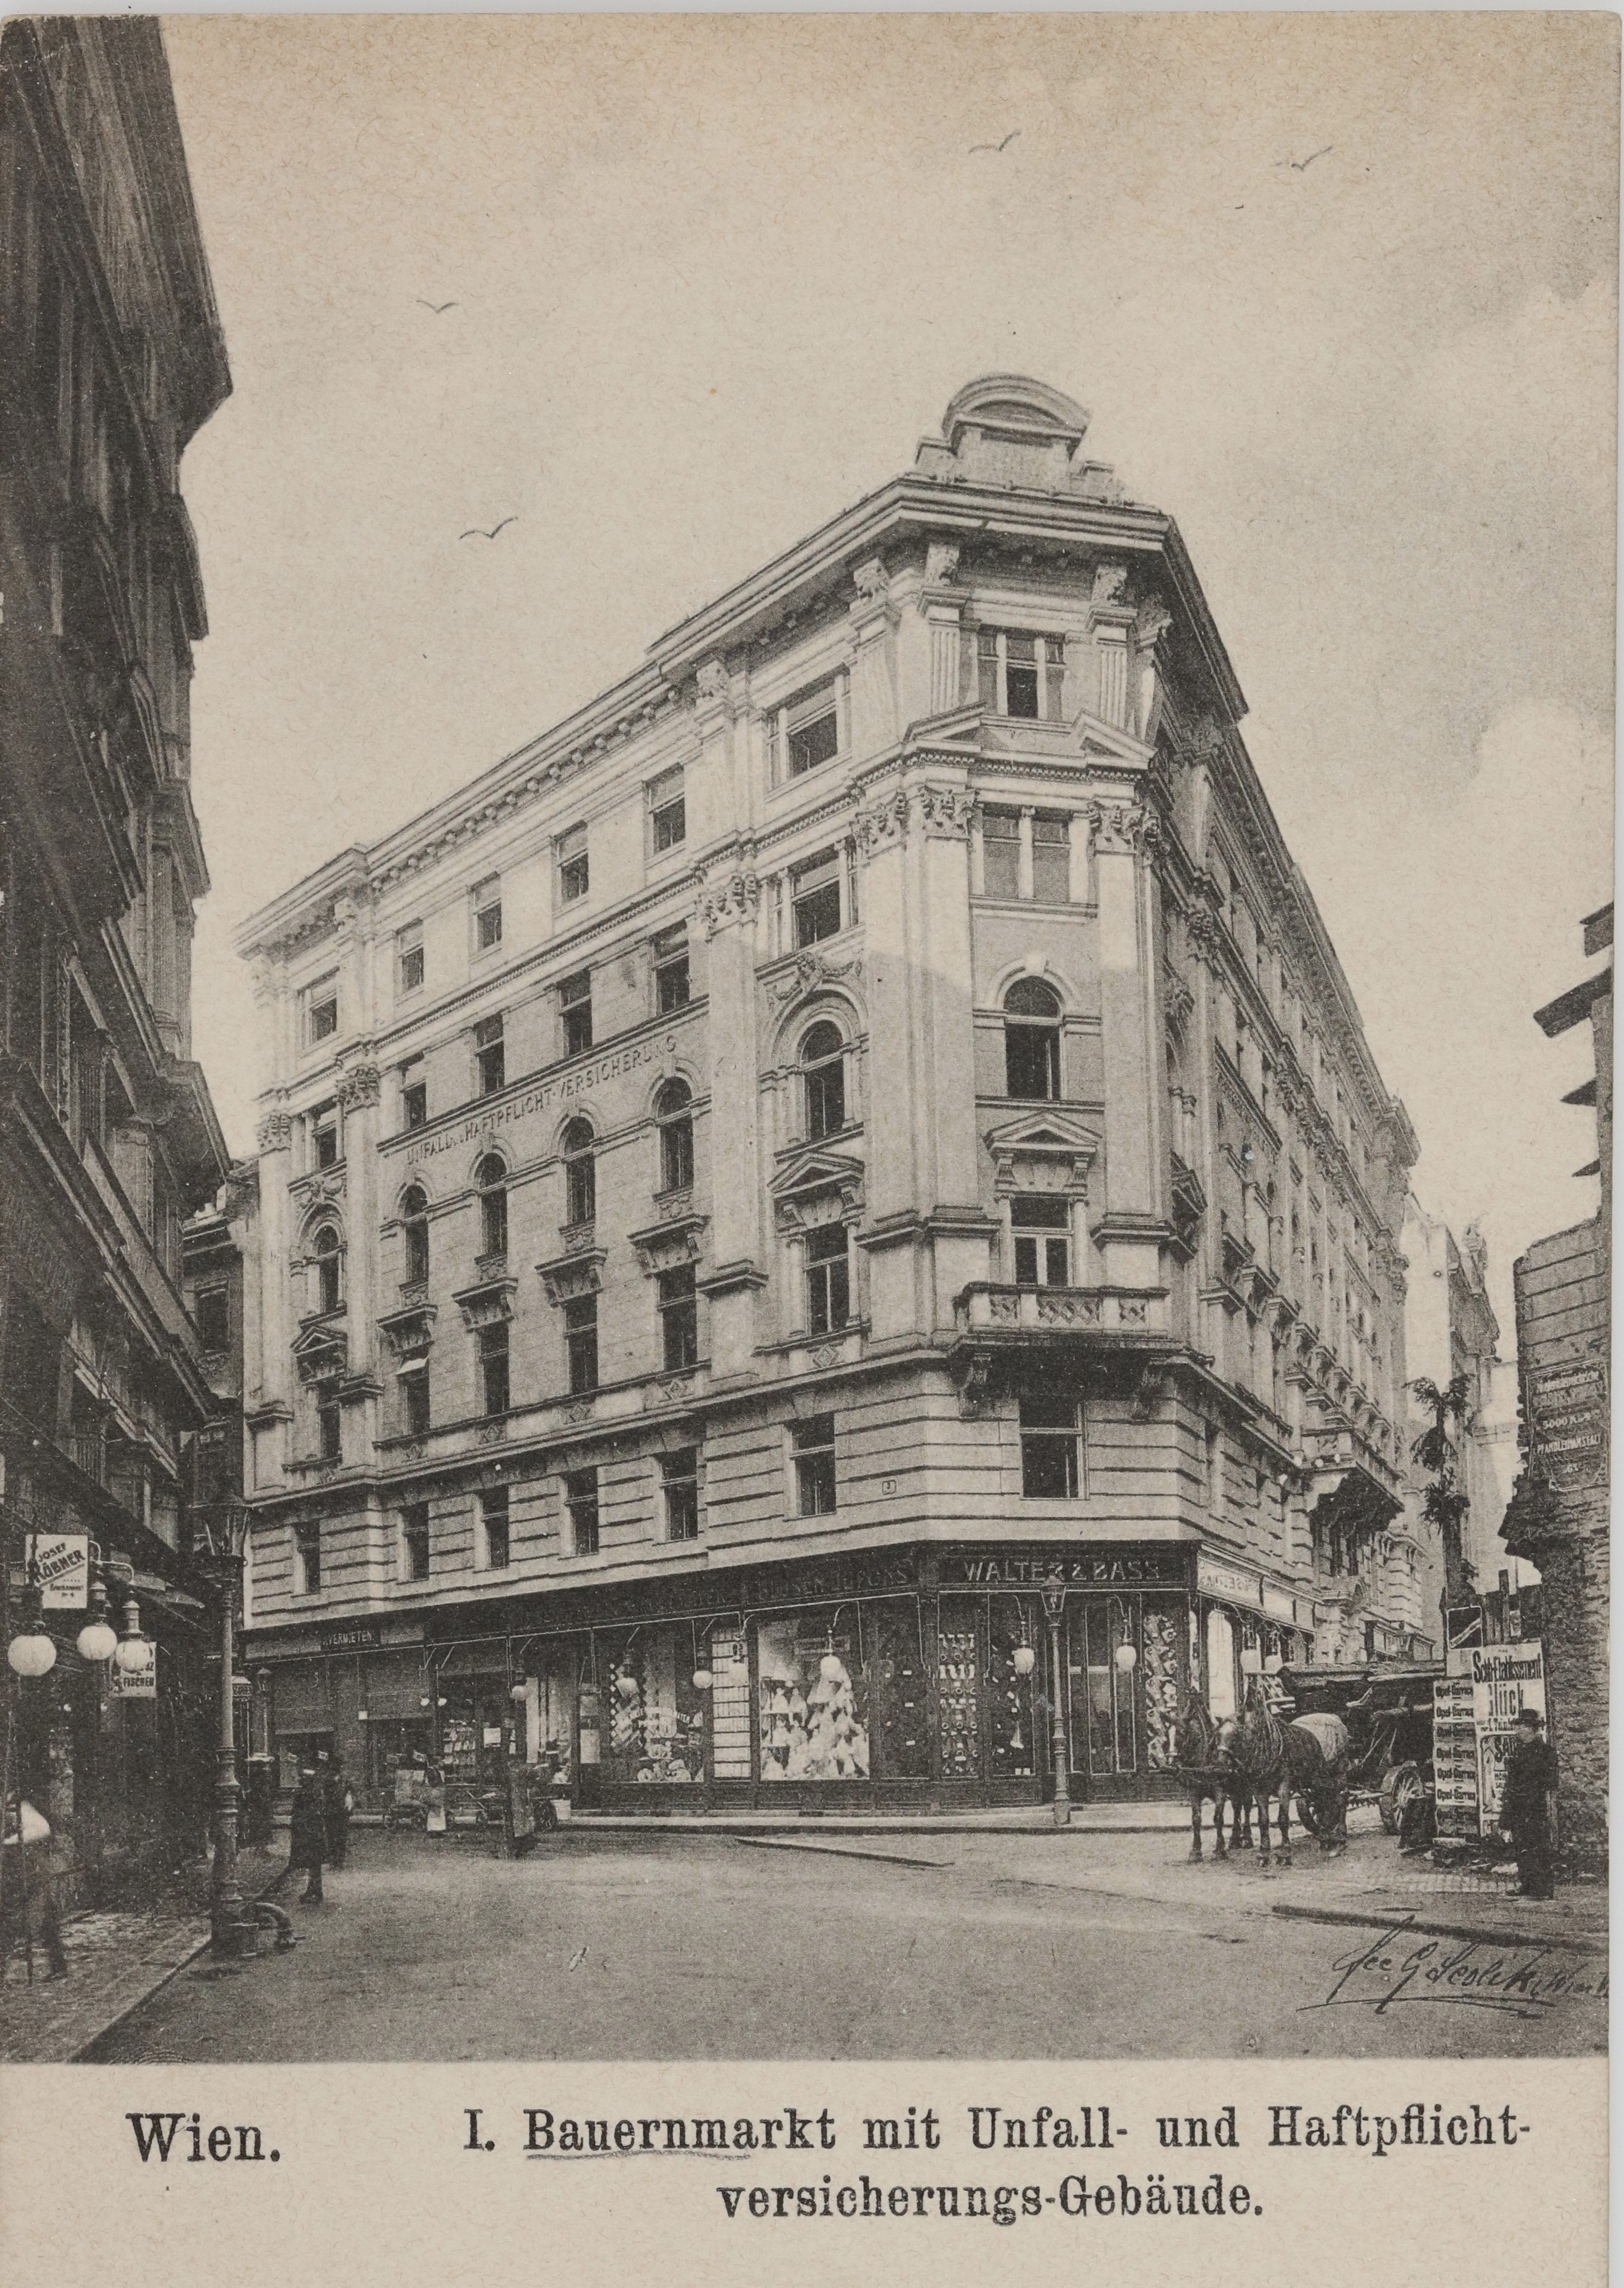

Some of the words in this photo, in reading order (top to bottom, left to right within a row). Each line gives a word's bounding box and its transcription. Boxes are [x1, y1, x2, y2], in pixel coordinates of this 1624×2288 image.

[964, 1560, 1065, 1581] WALTER
[1092, 1560, 1160, 1581] BASS
[123, 1677, 154, 1687] FISCHER
